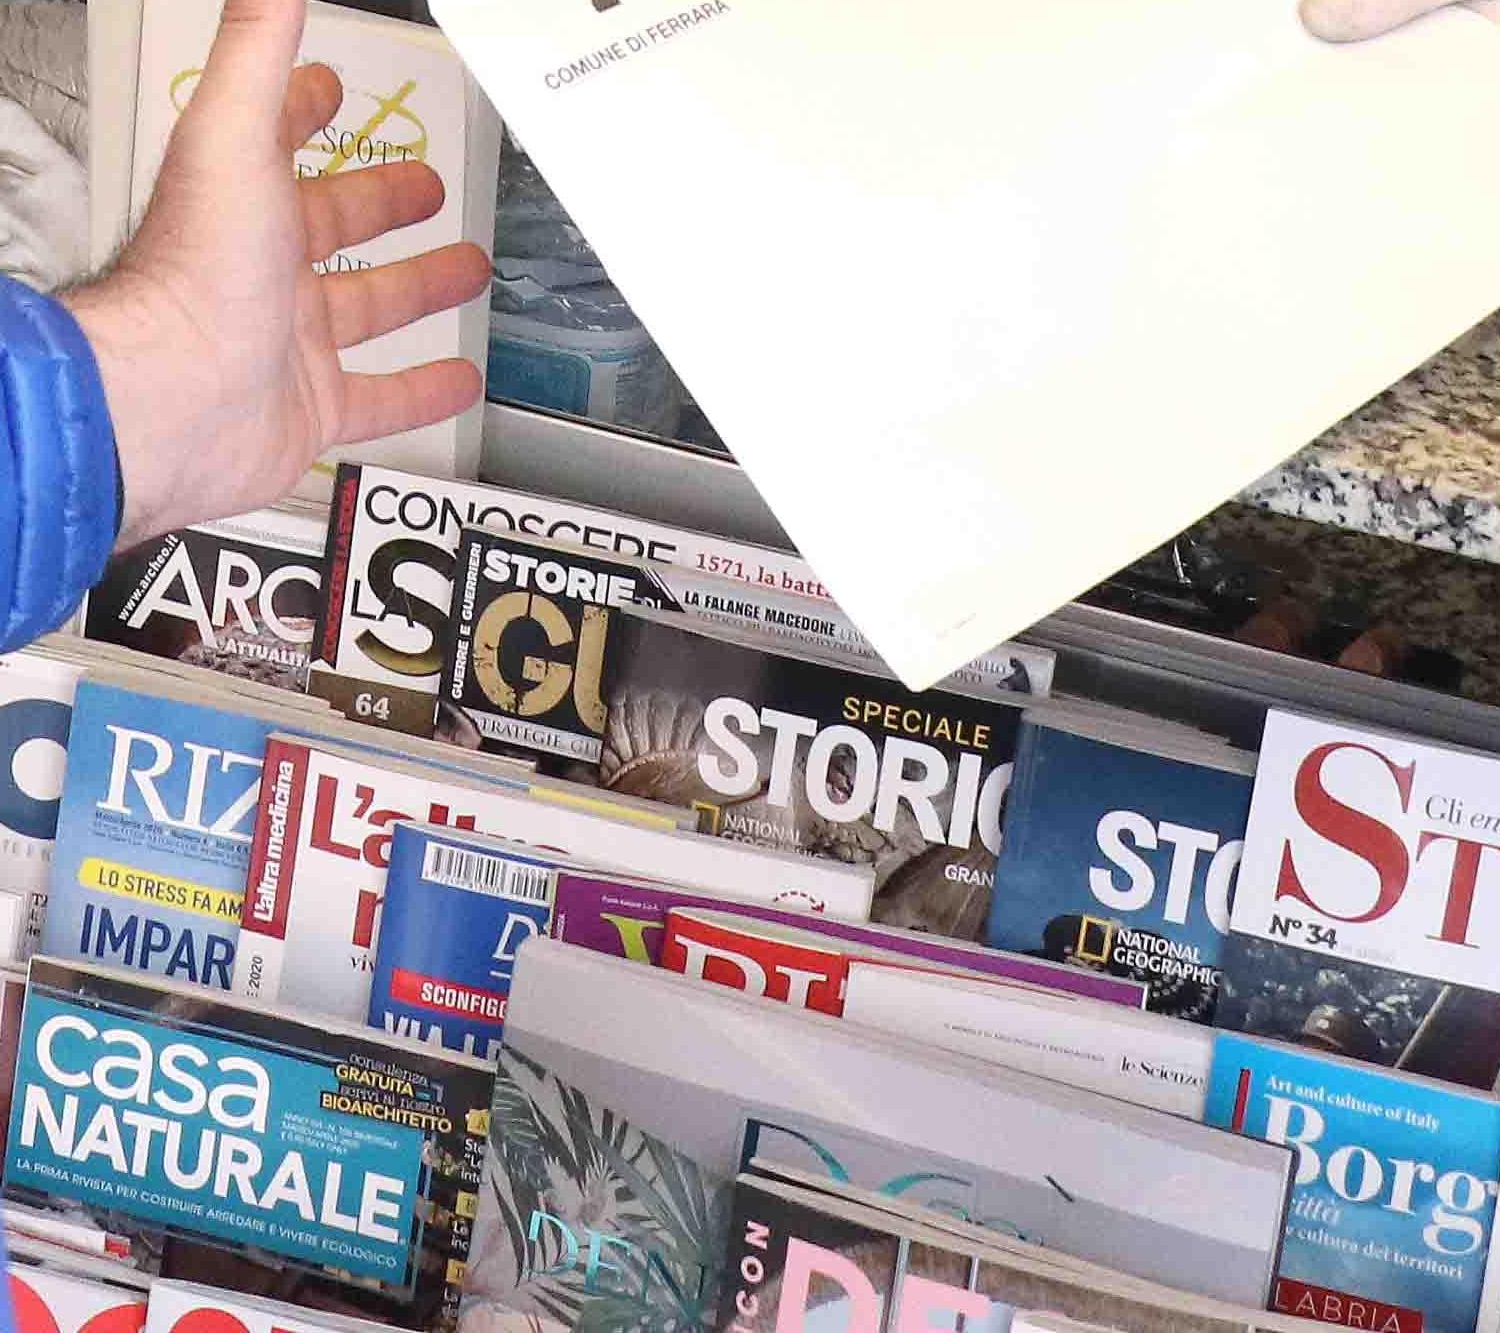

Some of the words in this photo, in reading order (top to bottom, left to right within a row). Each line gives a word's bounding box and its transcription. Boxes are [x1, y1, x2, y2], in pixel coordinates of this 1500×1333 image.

[545, 43, 628, 90] COMUNE
[483, 548, 637, 607] STORIE
[704, 594, 761, 621] FALANGE
[765, 607, 836, 637] MACEDONE
[355, 691, 390, 721] 64
[843, 697, 992, 749] SPECIALE
[125, 873, 188, 903] STRESS
[1116, 927, 1201, 962] NATIONAL
[35, 1015, 270, 1133] casa
[336, 1063, 414, 1097] GRATUITA
[322, 1093, 451, 1134] BIOARCHITETTO
[1326, 1087, 1382, 1118] culture
[21, 1083, 405, 1244] NATURALE
